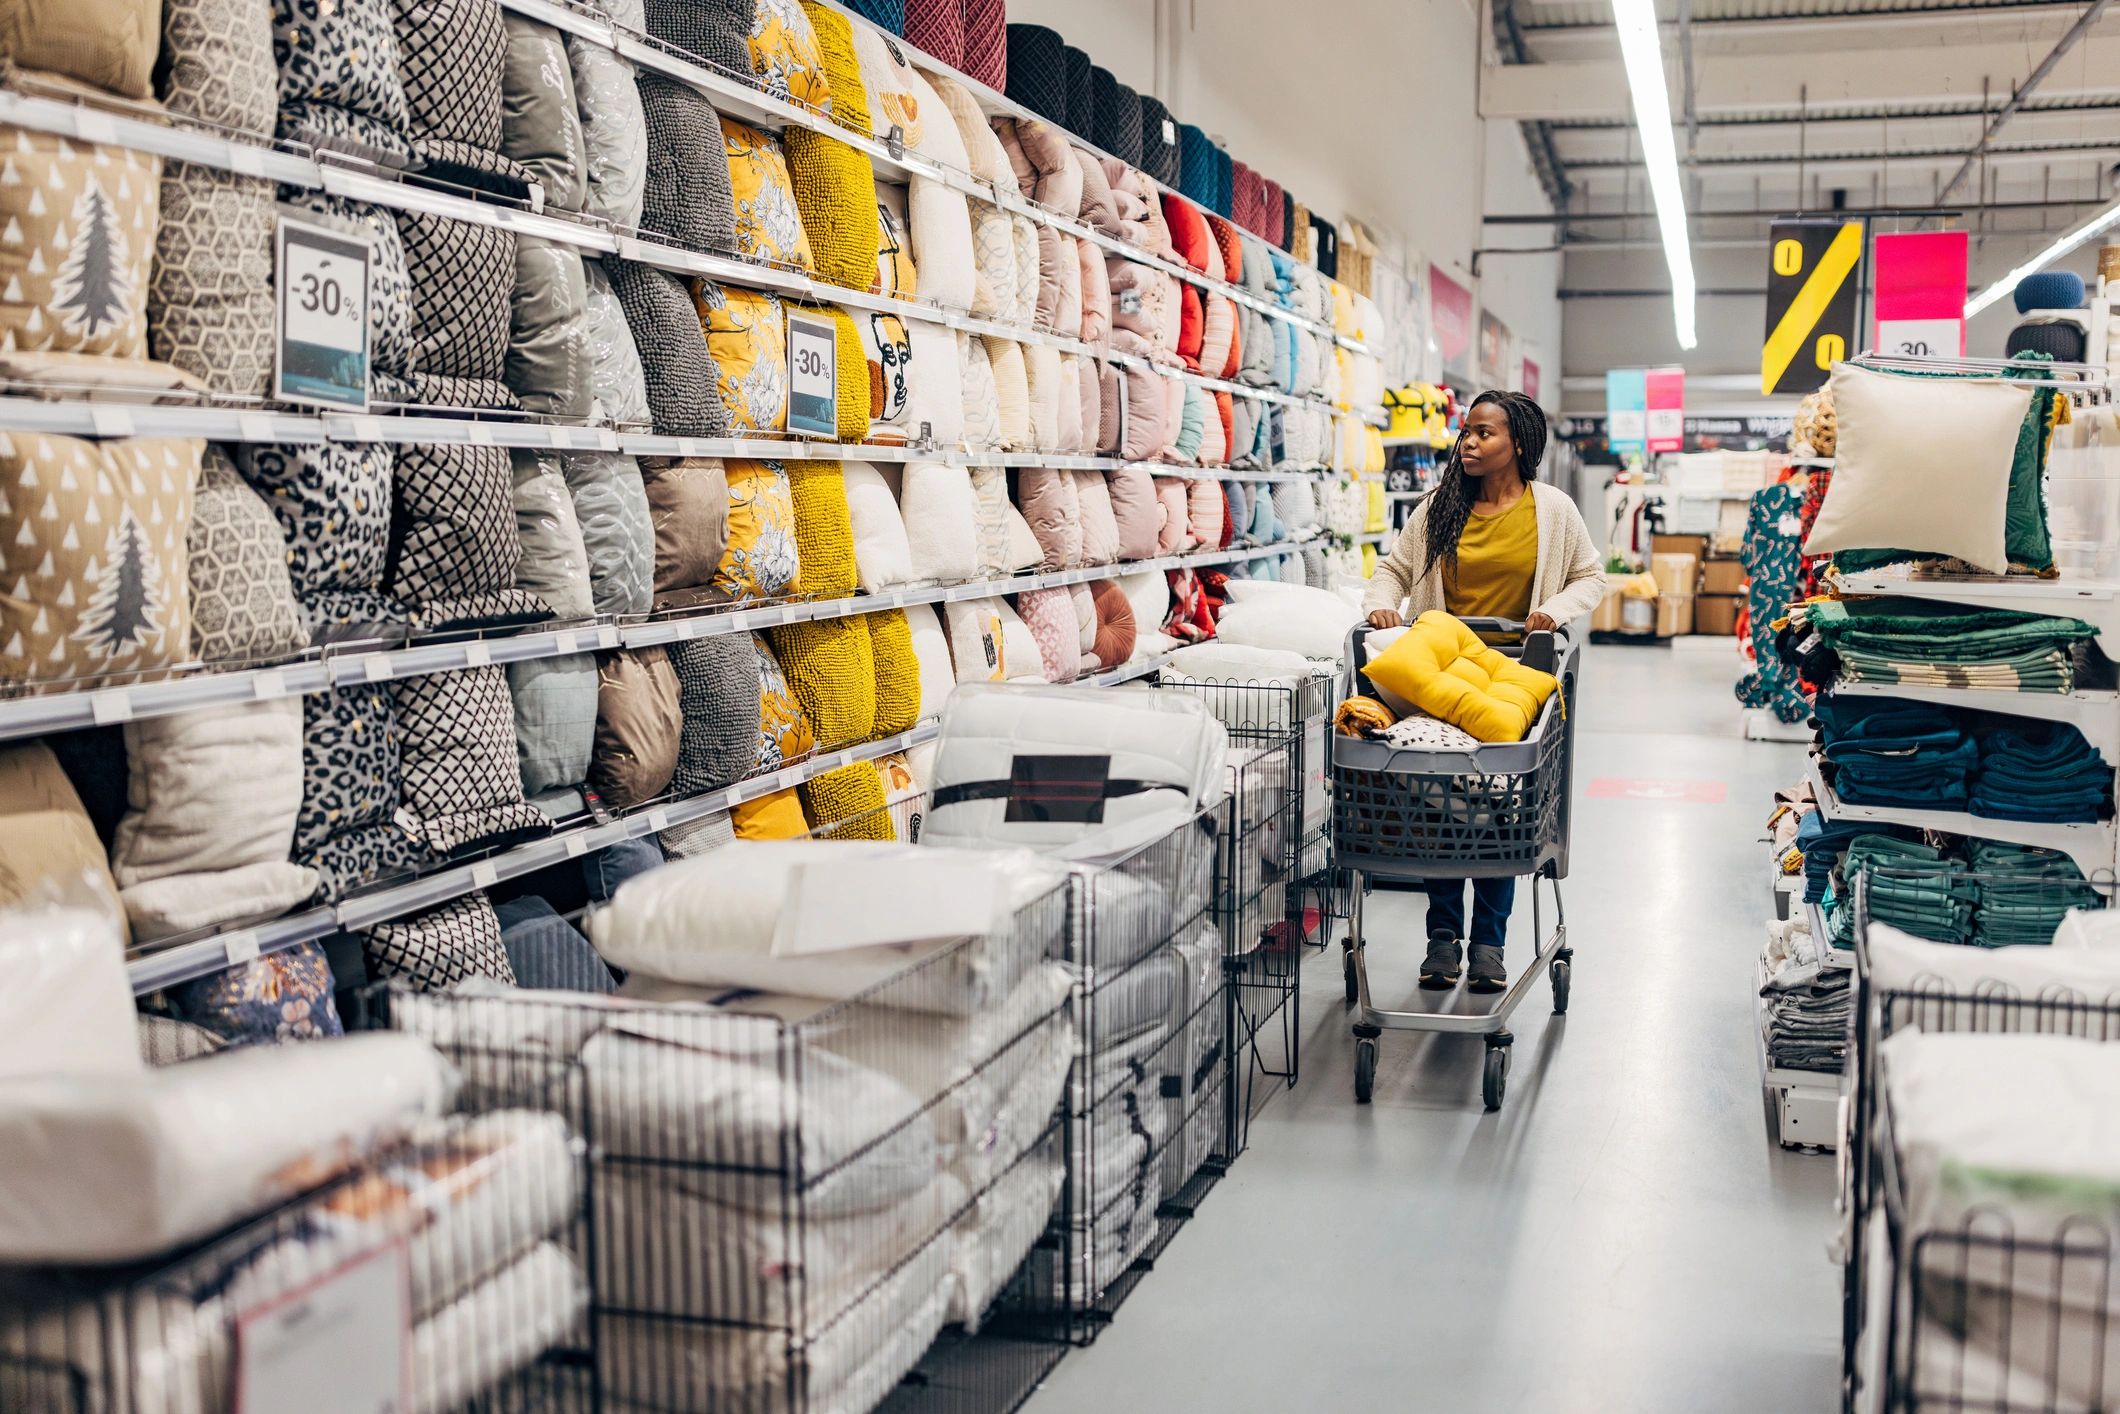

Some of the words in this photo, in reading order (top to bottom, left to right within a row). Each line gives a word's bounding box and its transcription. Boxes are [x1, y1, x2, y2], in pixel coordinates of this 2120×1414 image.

[292, 273, 359, 322] -30%
[795, 349, 830, 379] -30%
[1575, 419, 1595, 433] LG
